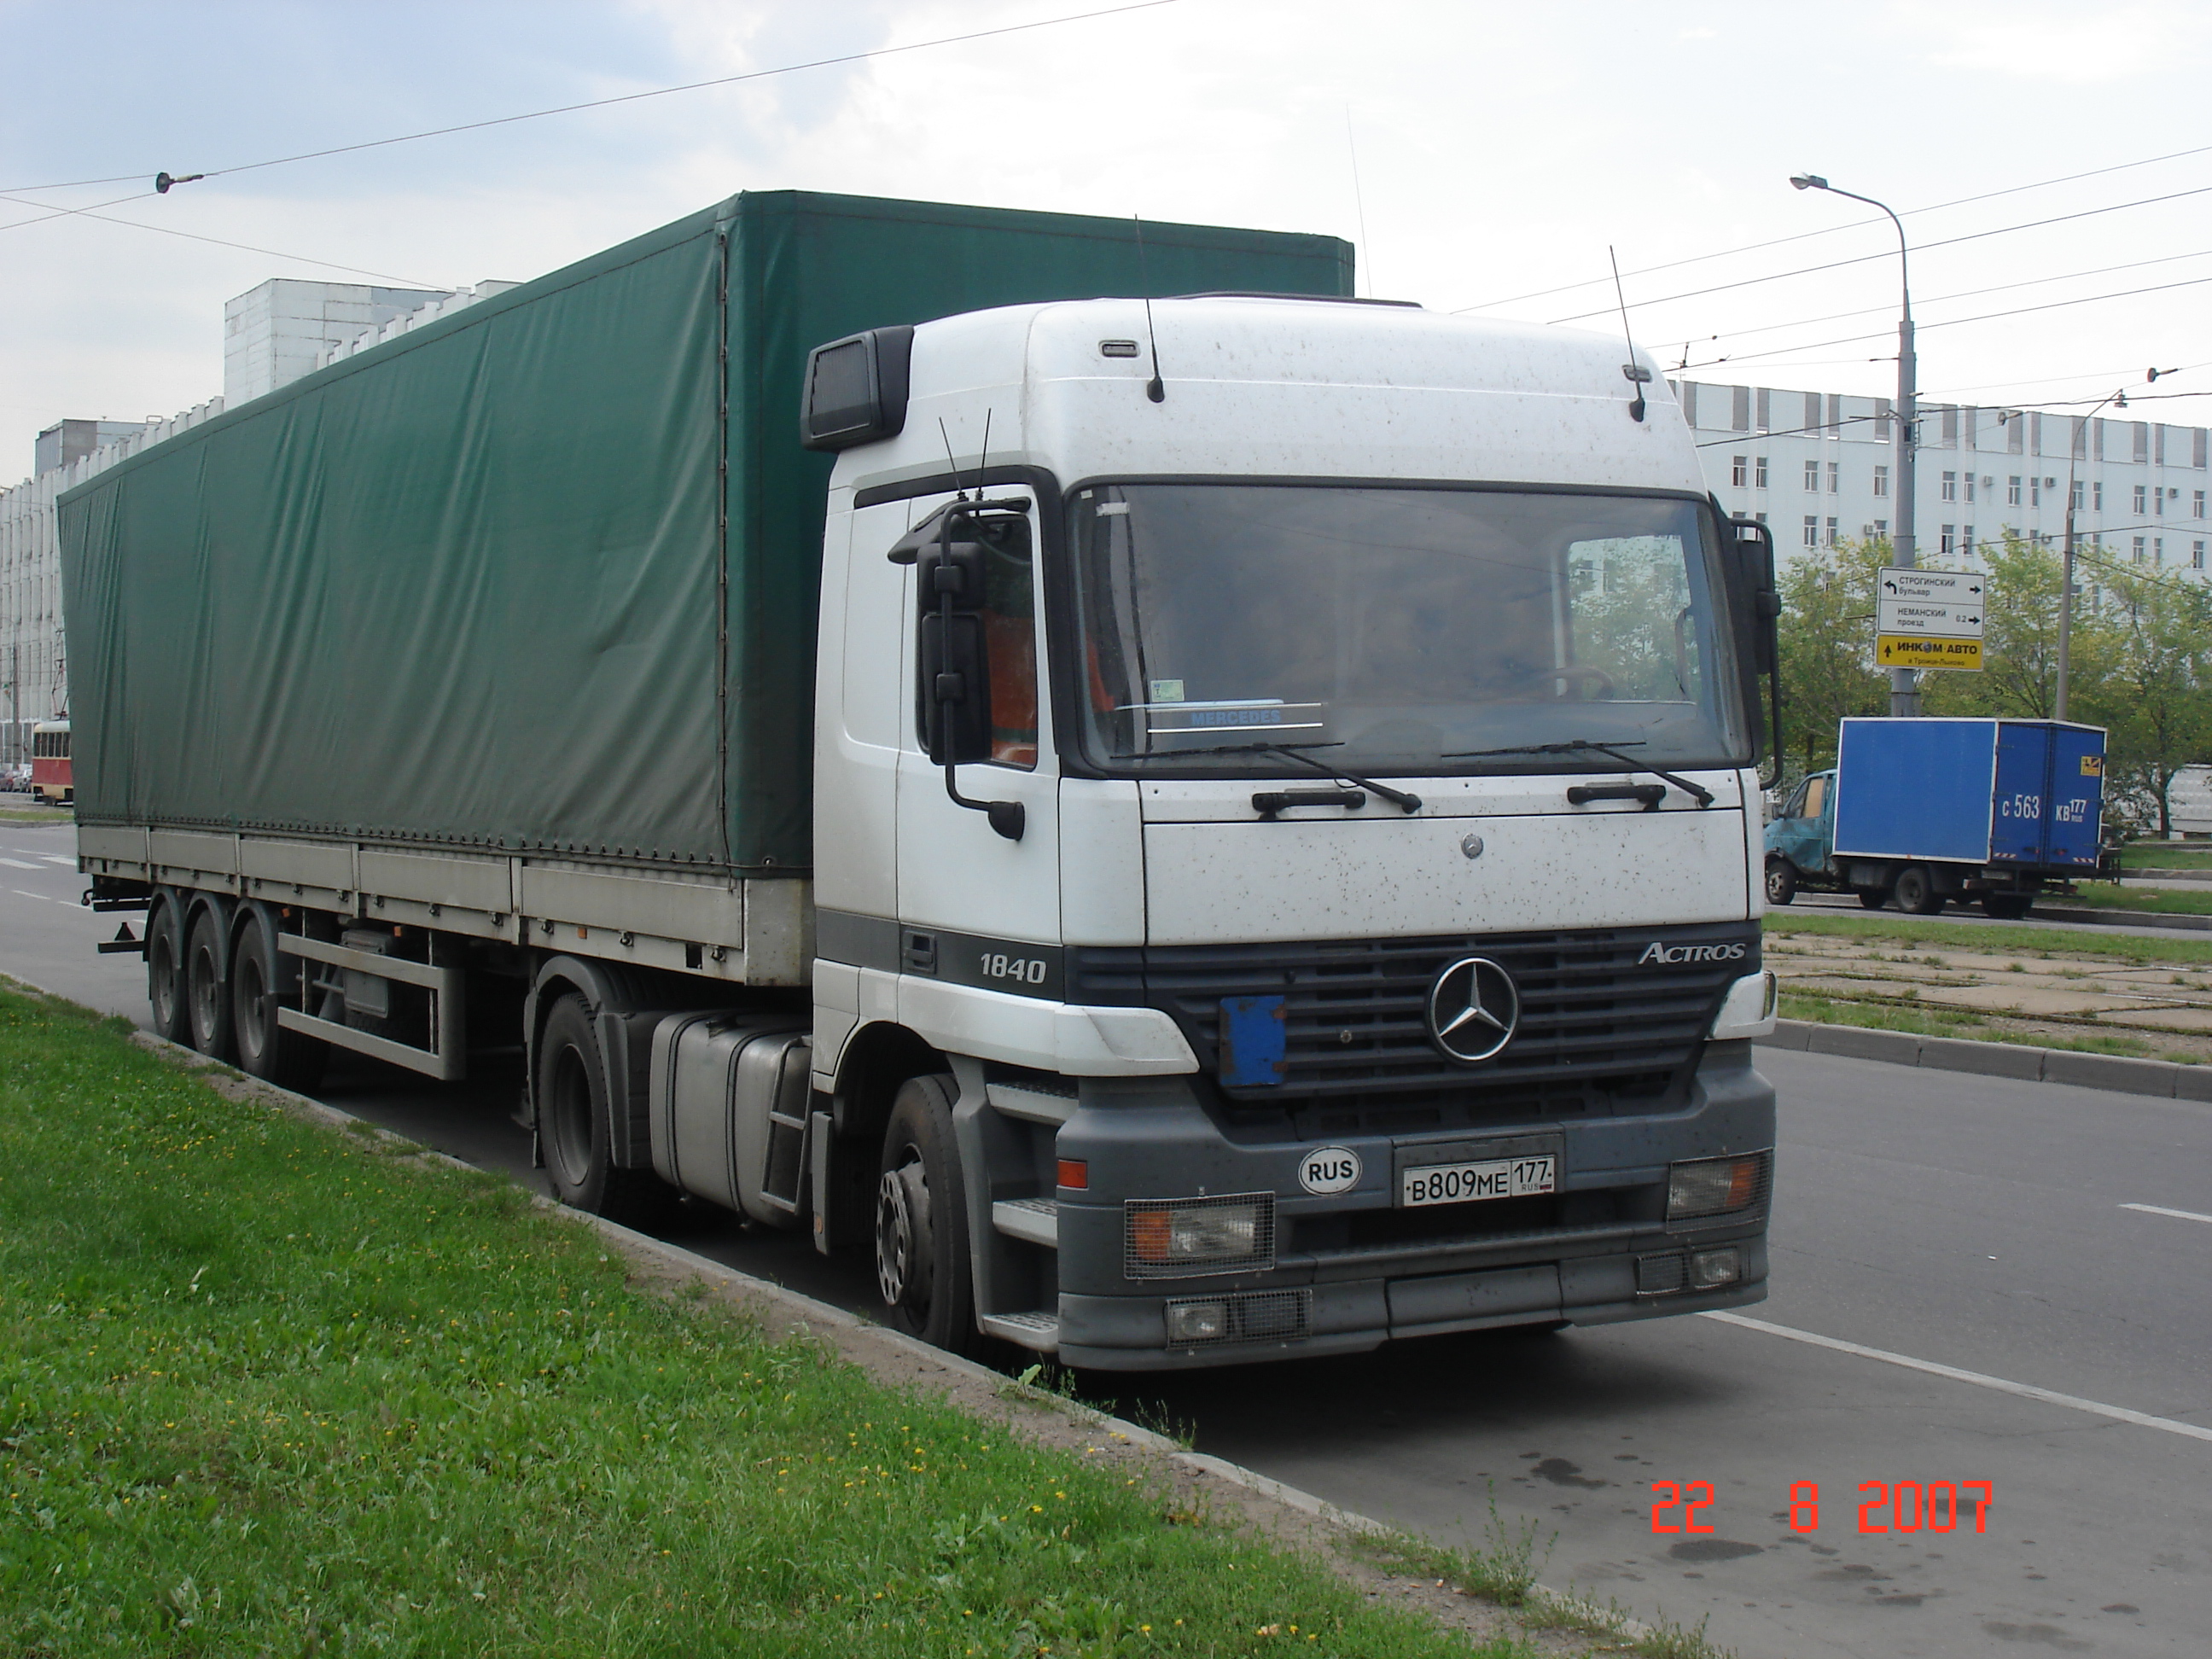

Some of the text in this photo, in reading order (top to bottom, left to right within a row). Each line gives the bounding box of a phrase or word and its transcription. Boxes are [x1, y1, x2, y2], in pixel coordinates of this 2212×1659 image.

[1899, 576, 1956, 587] СТРОГИНСКИЙ
[1899, 587, 1930, 597] бульвар
[1897, 608, 1947, 618] НЕМАНСКИЙ
[1897, 619, 1924, 627] проезд
[1191, 709, 1281, 725] MERCEDES
[2014, 794, 2040, 819] 563
[2069, 799, 2087, 814] 177
[981, 953, 1046, 984] 1840
[1308, 1160, 1353, 1182] RUS
[1514, 1161, 1549, 1184] 177
